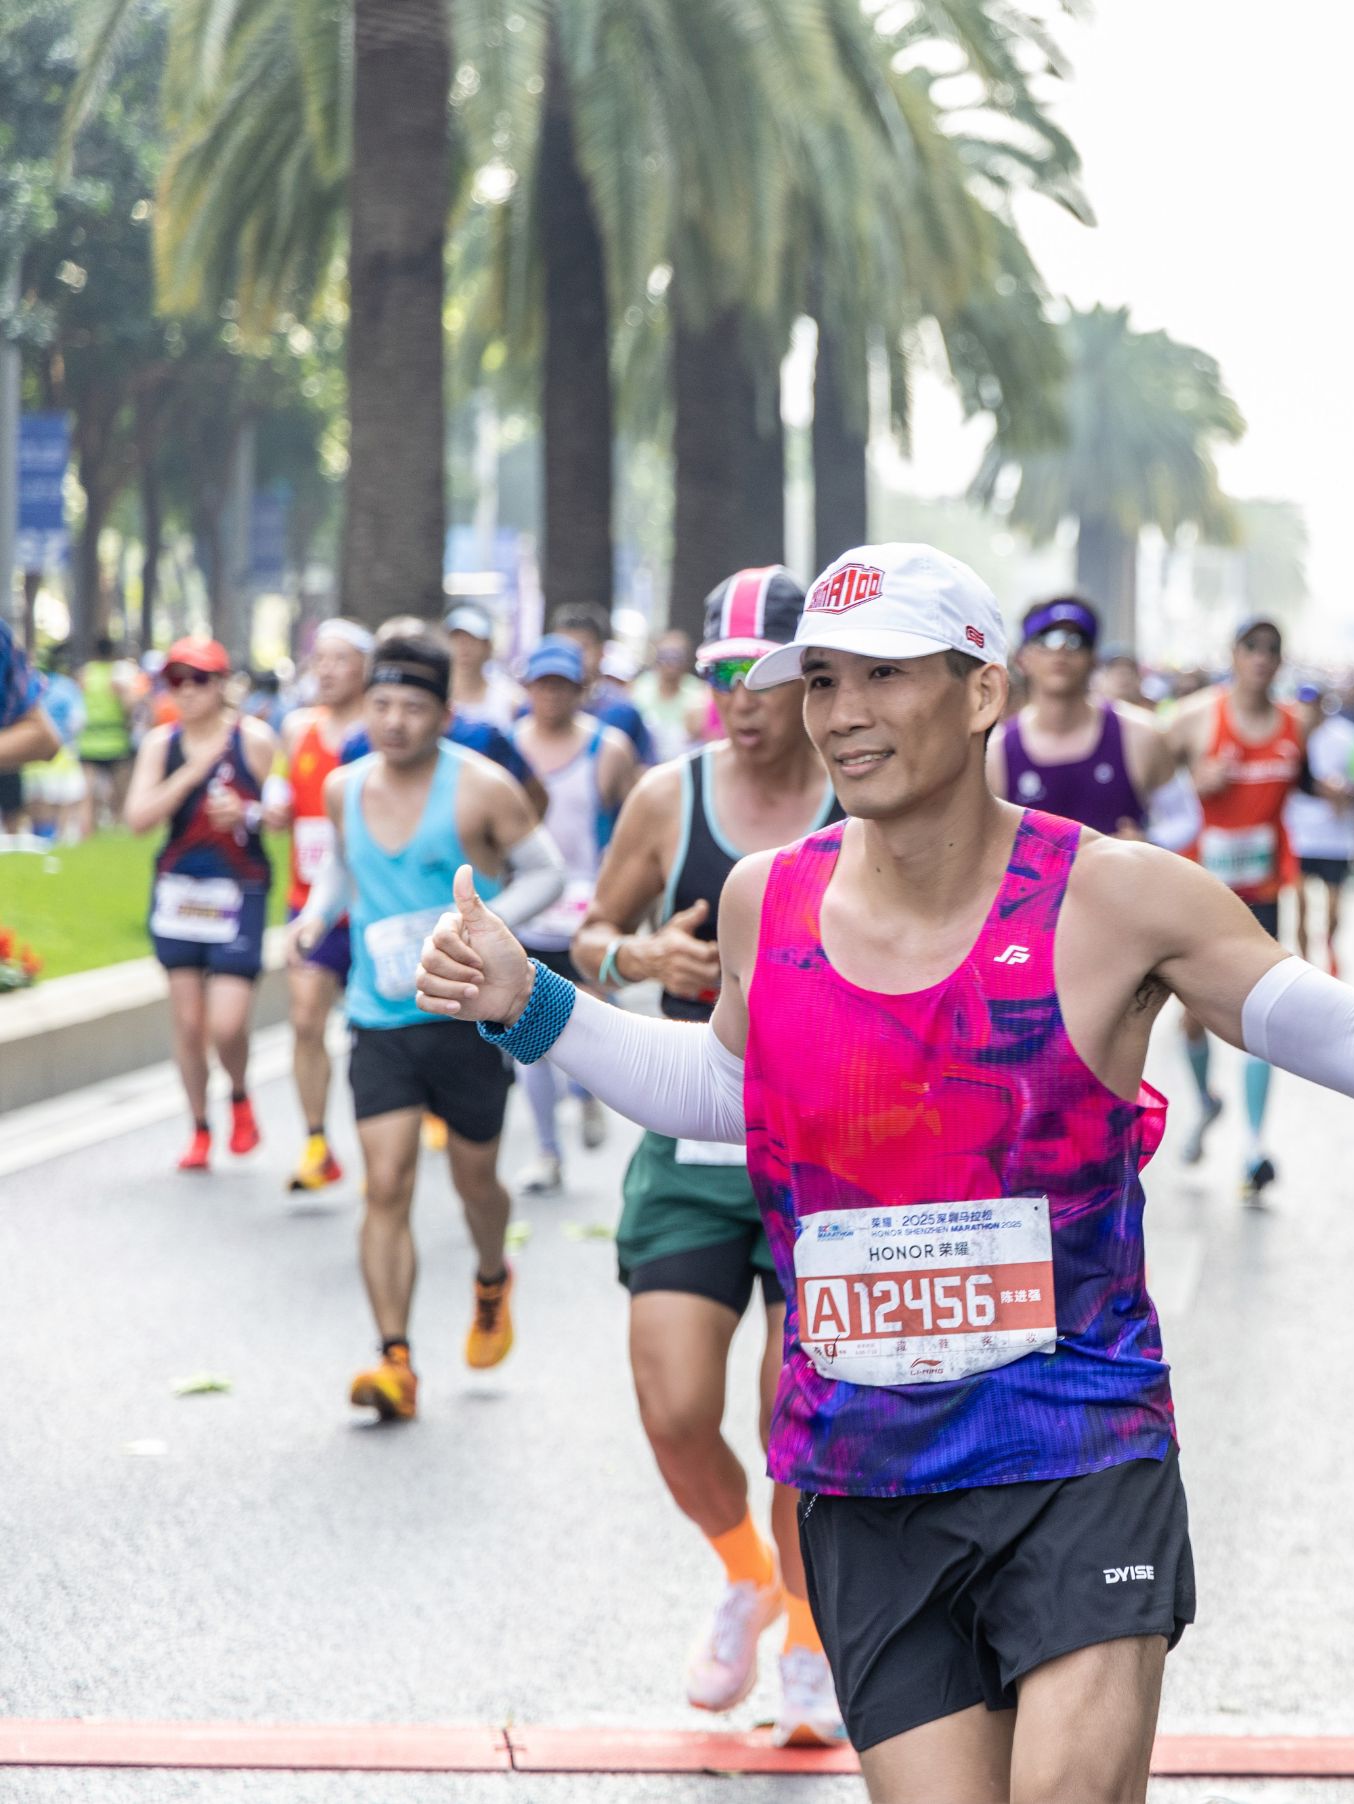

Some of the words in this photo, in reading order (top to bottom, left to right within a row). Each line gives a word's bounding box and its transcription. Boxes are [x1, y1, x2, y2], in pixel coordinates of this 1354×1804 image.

[950, 1222, 1000, 1232] MARATHON
[869, 1244, 935, 1262] HONOR
[939, 1241, 969, 1257] 荣耀
[1102, 1565, 1155, 1585] DYISE
